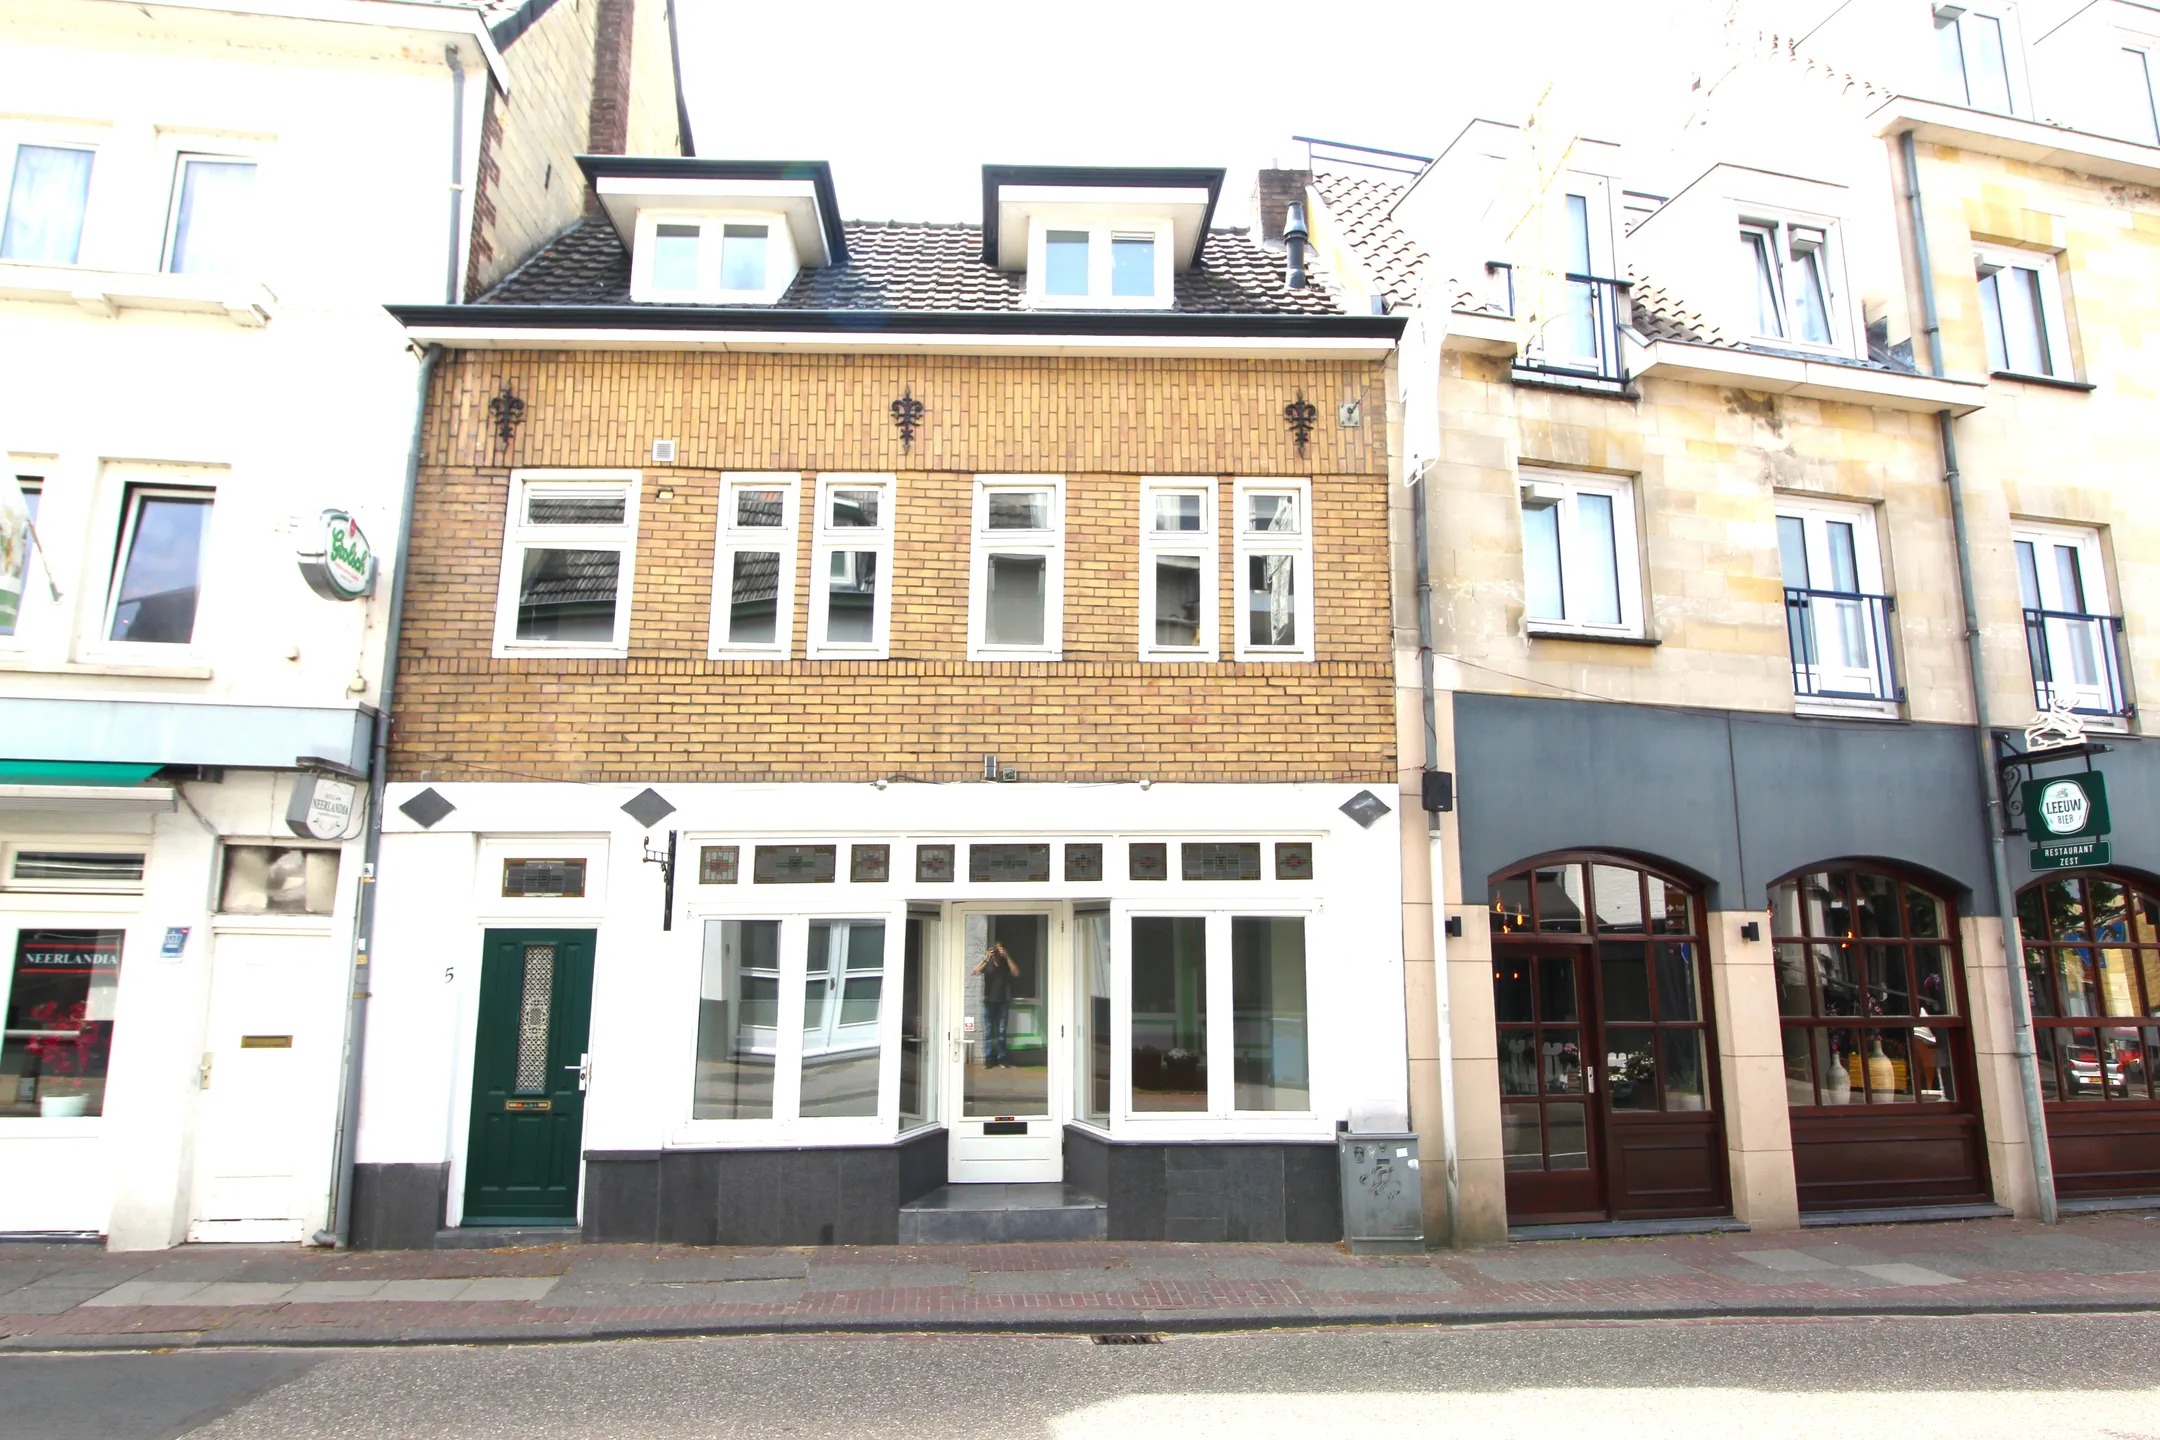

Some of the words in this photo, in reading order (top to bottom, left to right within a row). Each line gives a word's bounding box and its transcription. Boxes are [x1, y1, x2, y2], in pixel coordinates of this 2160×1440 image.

[331, 527, 368, 576] Grolsch
[313, 799, 349, 815] NEERLANDIA
[2046, 798, 2081, 814] LEEUW
[2057, 814, 2074, 824] BIER
[2044, 844, 2093, 857] RESTAURANT
[2060, 857, 2079, 866] ZEST
[24, 953, 119, 964] NEERLANDIA
[445, 966, 454, 984] 5
